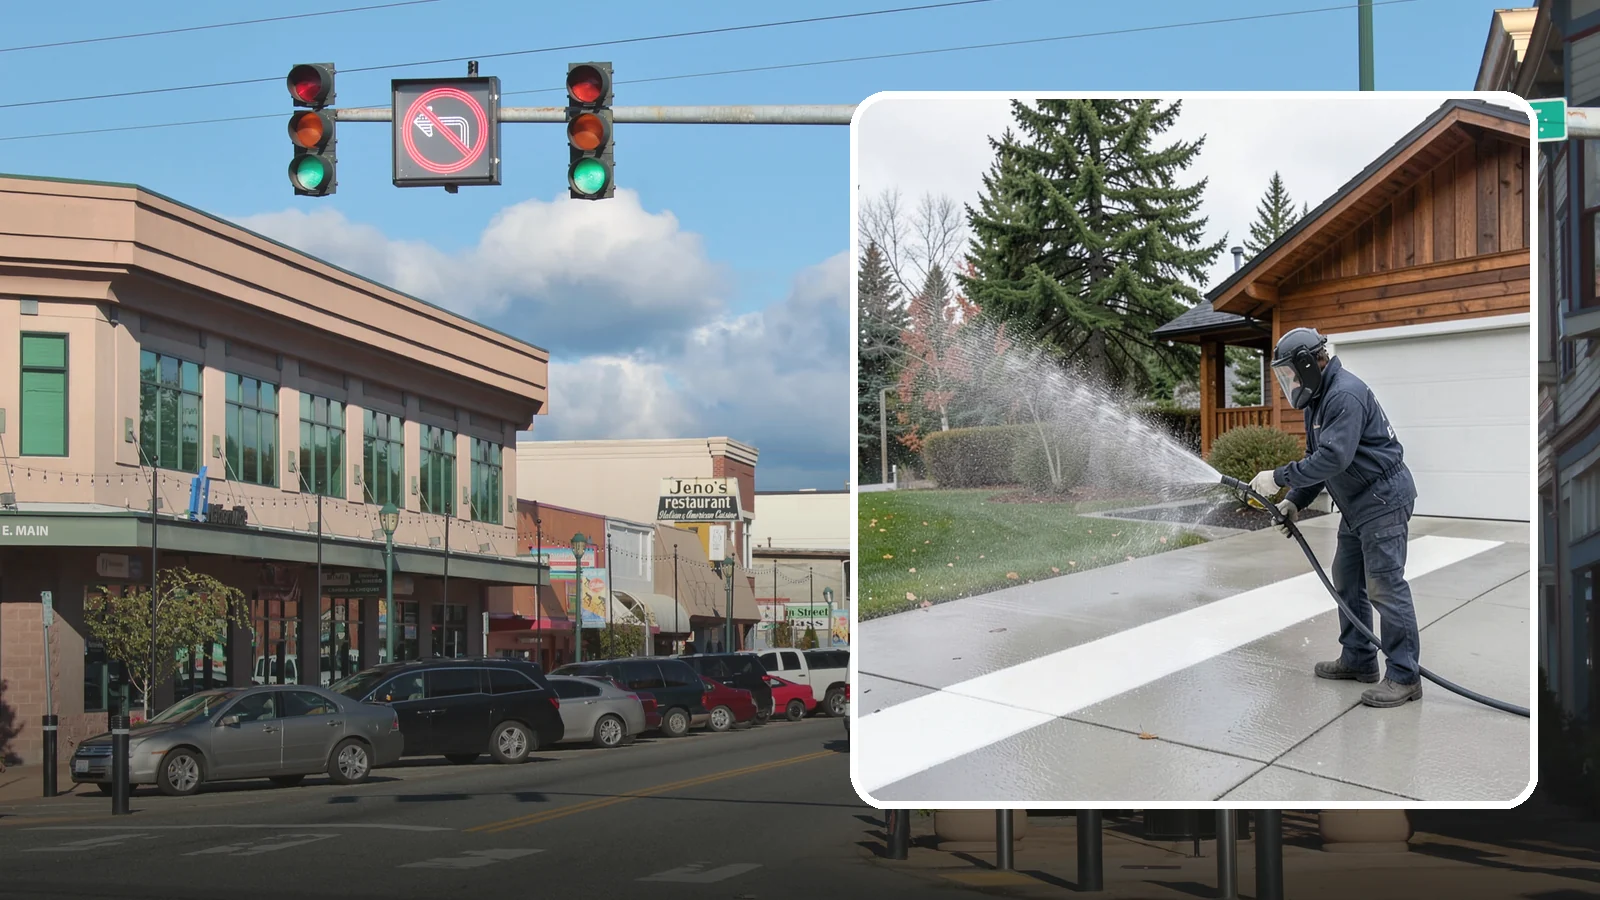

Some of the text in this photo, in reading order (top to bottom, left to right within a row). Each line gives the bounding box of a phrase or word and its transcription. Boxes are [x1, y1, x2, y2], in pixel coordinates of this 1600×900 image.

[670, 480, 727, 494] Jeno's
[665, 496, 731, 509] restaurant
[659, 510, 682, 519] Italian
[686, 509, 714, 519] American
[715, 509, 737, 519] Cuisine
[2, 525, 49, 536] E. MAIN
[797, 608, 828, 617] Street
